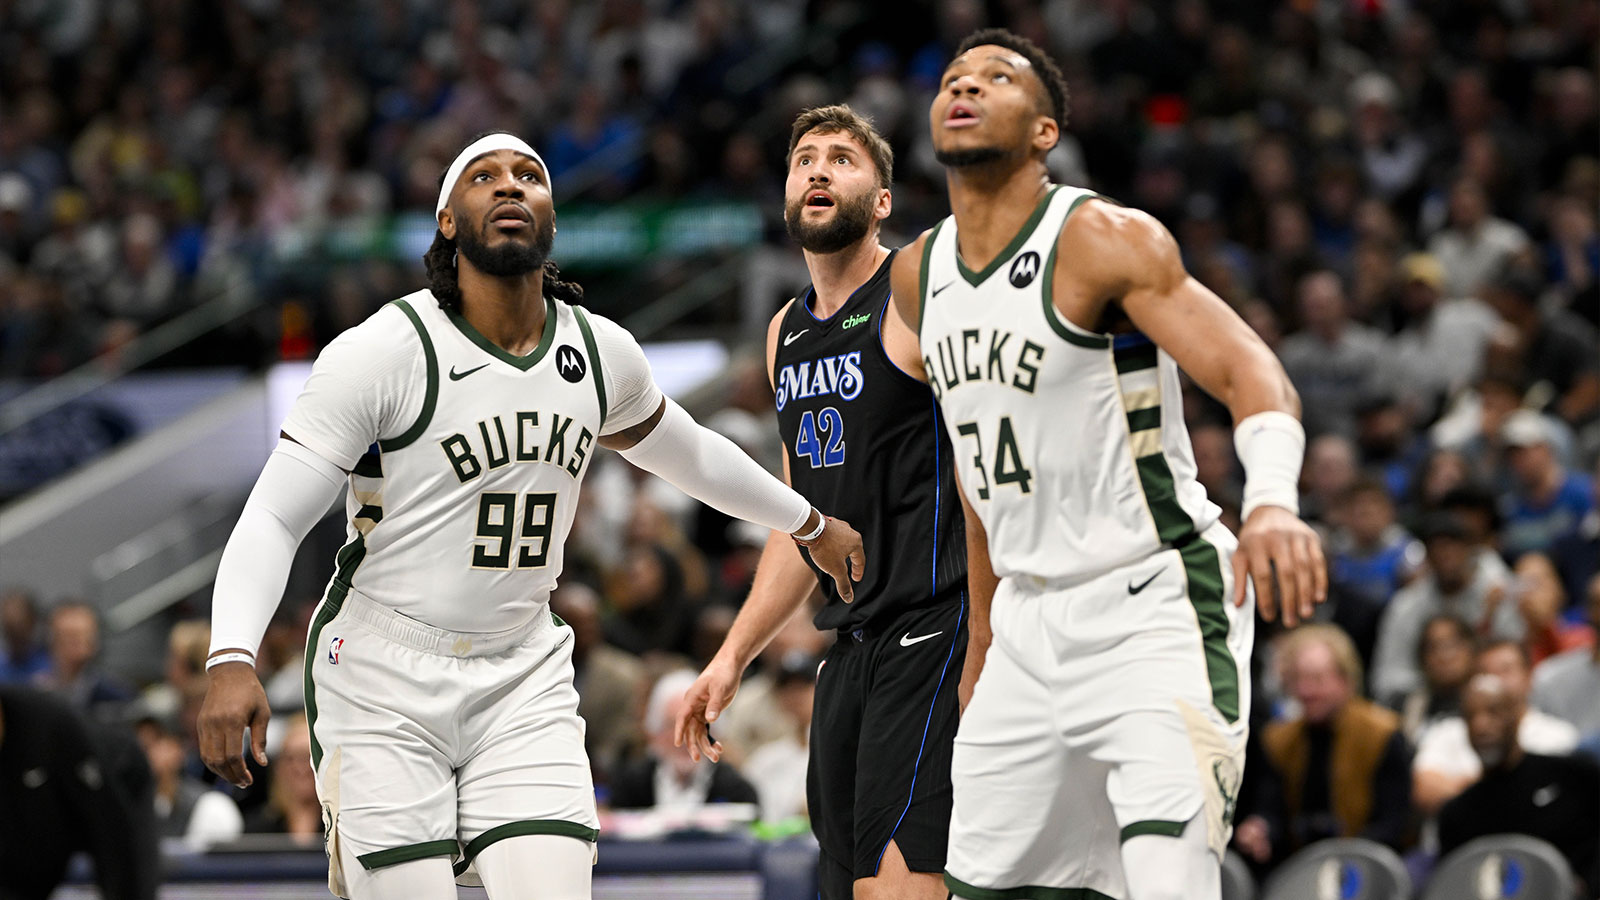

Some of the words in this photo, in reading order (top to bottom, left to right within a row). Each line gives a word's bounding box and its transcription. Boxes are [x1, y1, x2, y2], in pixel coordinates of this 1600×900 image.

[775, 351, 865, 412] MAVS
[922, 327, 1045, 401] BUCKS
[440, 410, 594, 484] BUCKS
[795, 406, 845, 469] 42
[955, 414, 1033, 502] 34
[470, 491, 559, 571] 99
